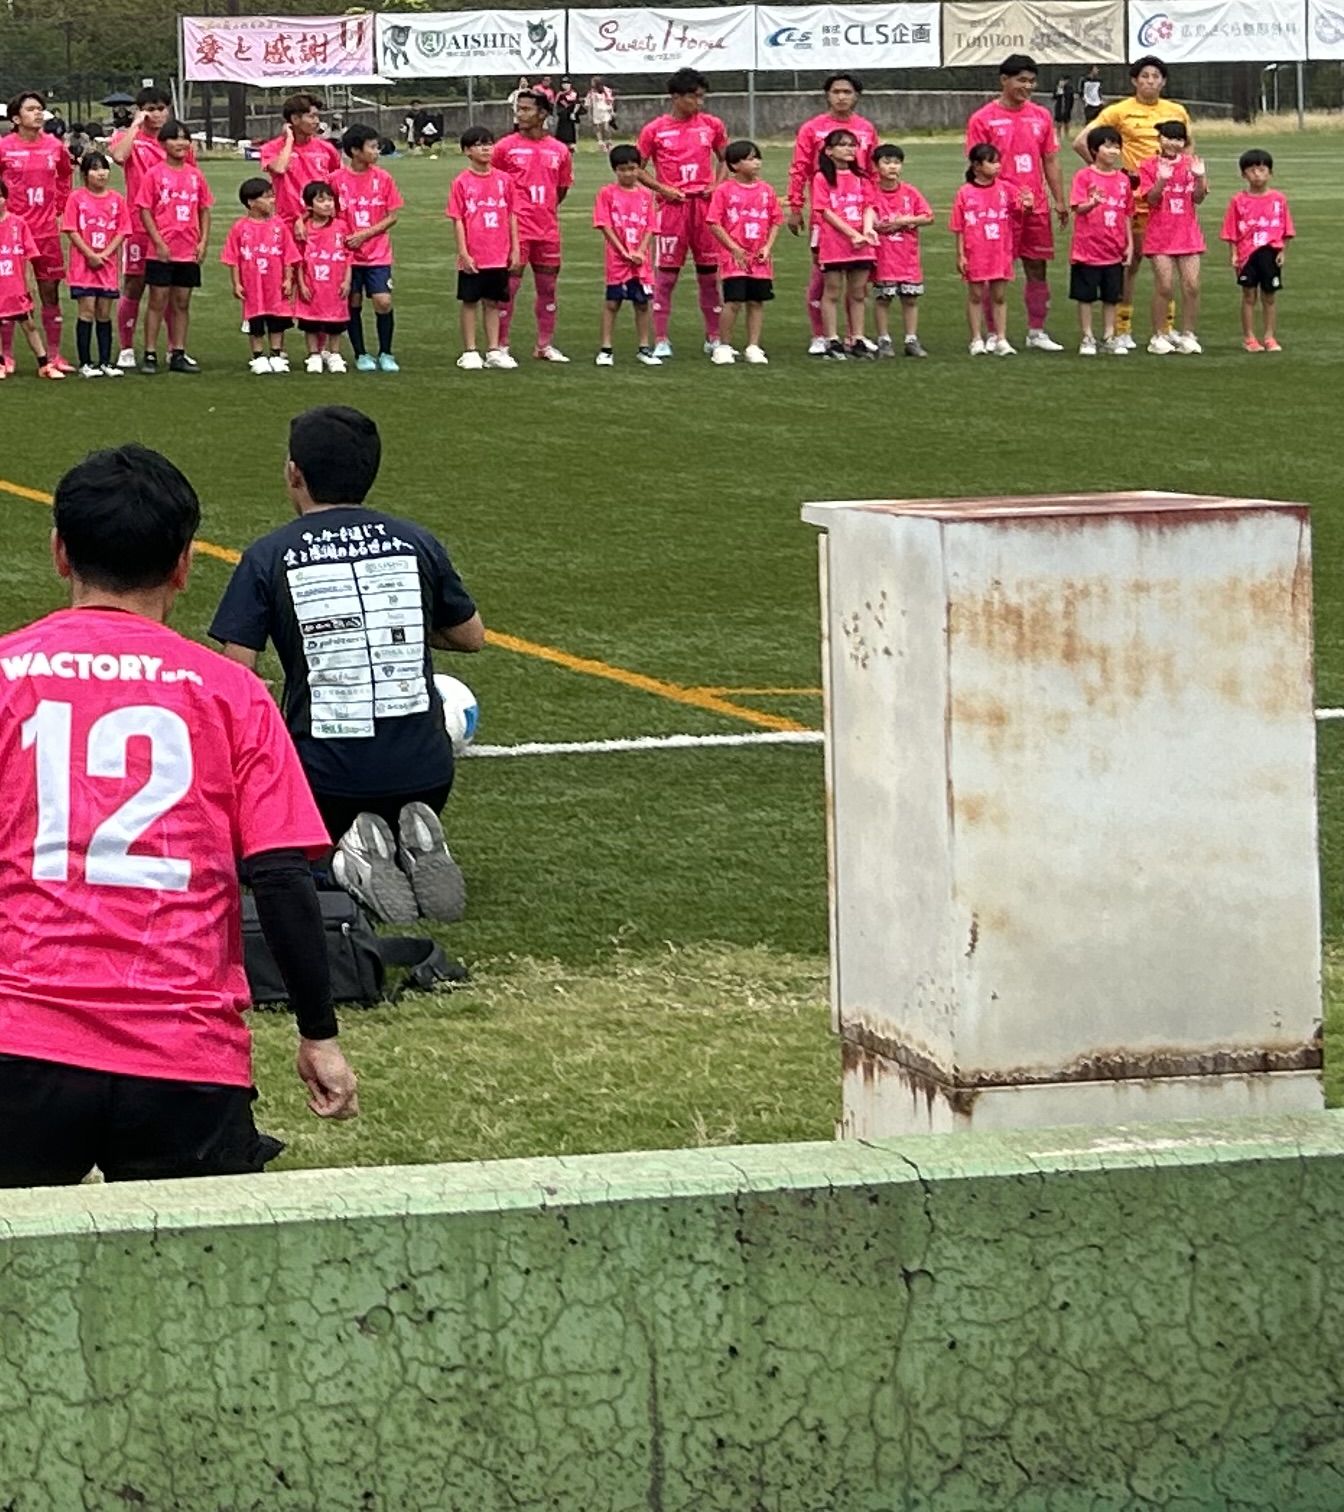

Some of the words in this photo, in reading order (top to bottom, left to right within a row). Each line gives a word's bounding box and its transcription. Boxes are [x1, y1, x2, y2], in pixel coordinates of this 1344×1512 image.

[446, 33, 521, 50] AISHIN
[844, 22, 931, 45] CLS企画
[195, 32, 329, 66] 愛と感謝
[679, 163, 699, 183] 17
[26, 187, 44, 206] 14
[529, 185, 545, 204] 11
[175, 205, 190, 221] 12
[1169, 198, 1184, 214] 12
[354, 211, 371, 227] 12
[483, 211, 499, 227] 12
[1103, 210, 1116, 227] 12
[744, 223, 759, 239] 12
[984, 222, 1000, 240] 12
[91, 232, 106, 249] 12
[661, 236, 678, 254] 17
[314, 265, 330, 280] 12
[302, 523, 387, 545] サッカーを通じて
[0, 652, 163, 681] WACTORY
[20, 699, 193, 892] 12
